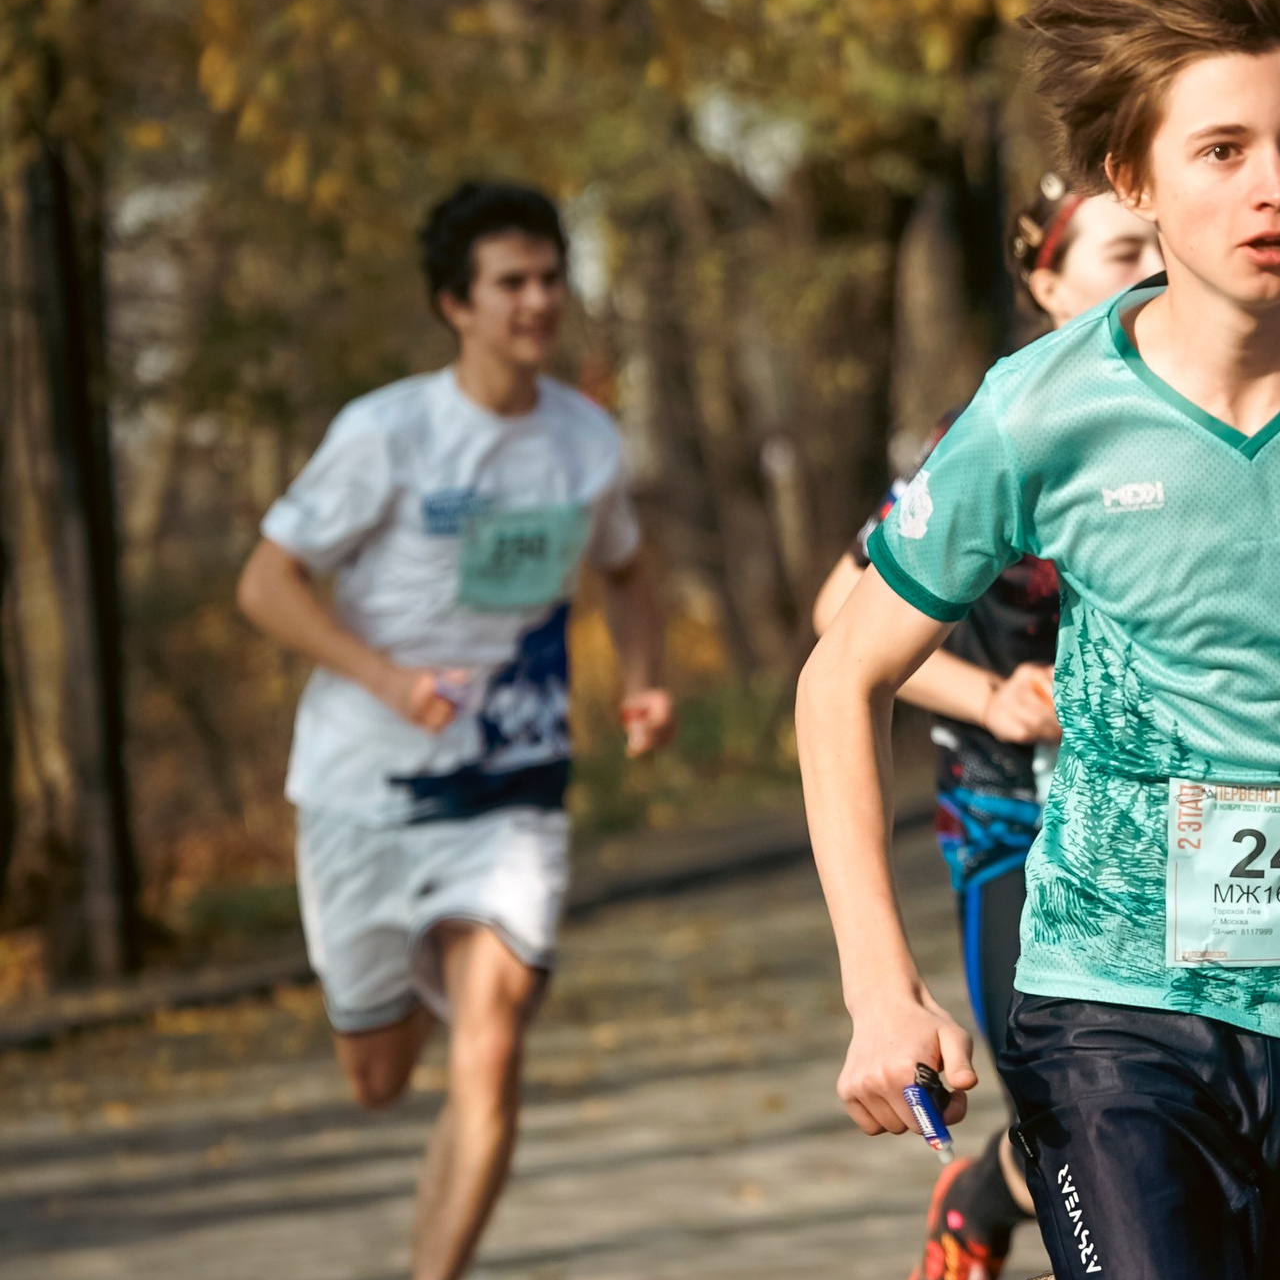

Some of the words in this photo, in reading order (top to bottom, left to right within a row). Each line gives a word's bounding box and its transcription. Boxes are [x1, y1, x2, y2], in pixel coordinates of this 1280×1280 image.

[1177, 783, 1203, 832] ЭТАП
[1177, 837, 1202, 850] 2
[1057, 1163, 1102, 1274] ARSWEAR
